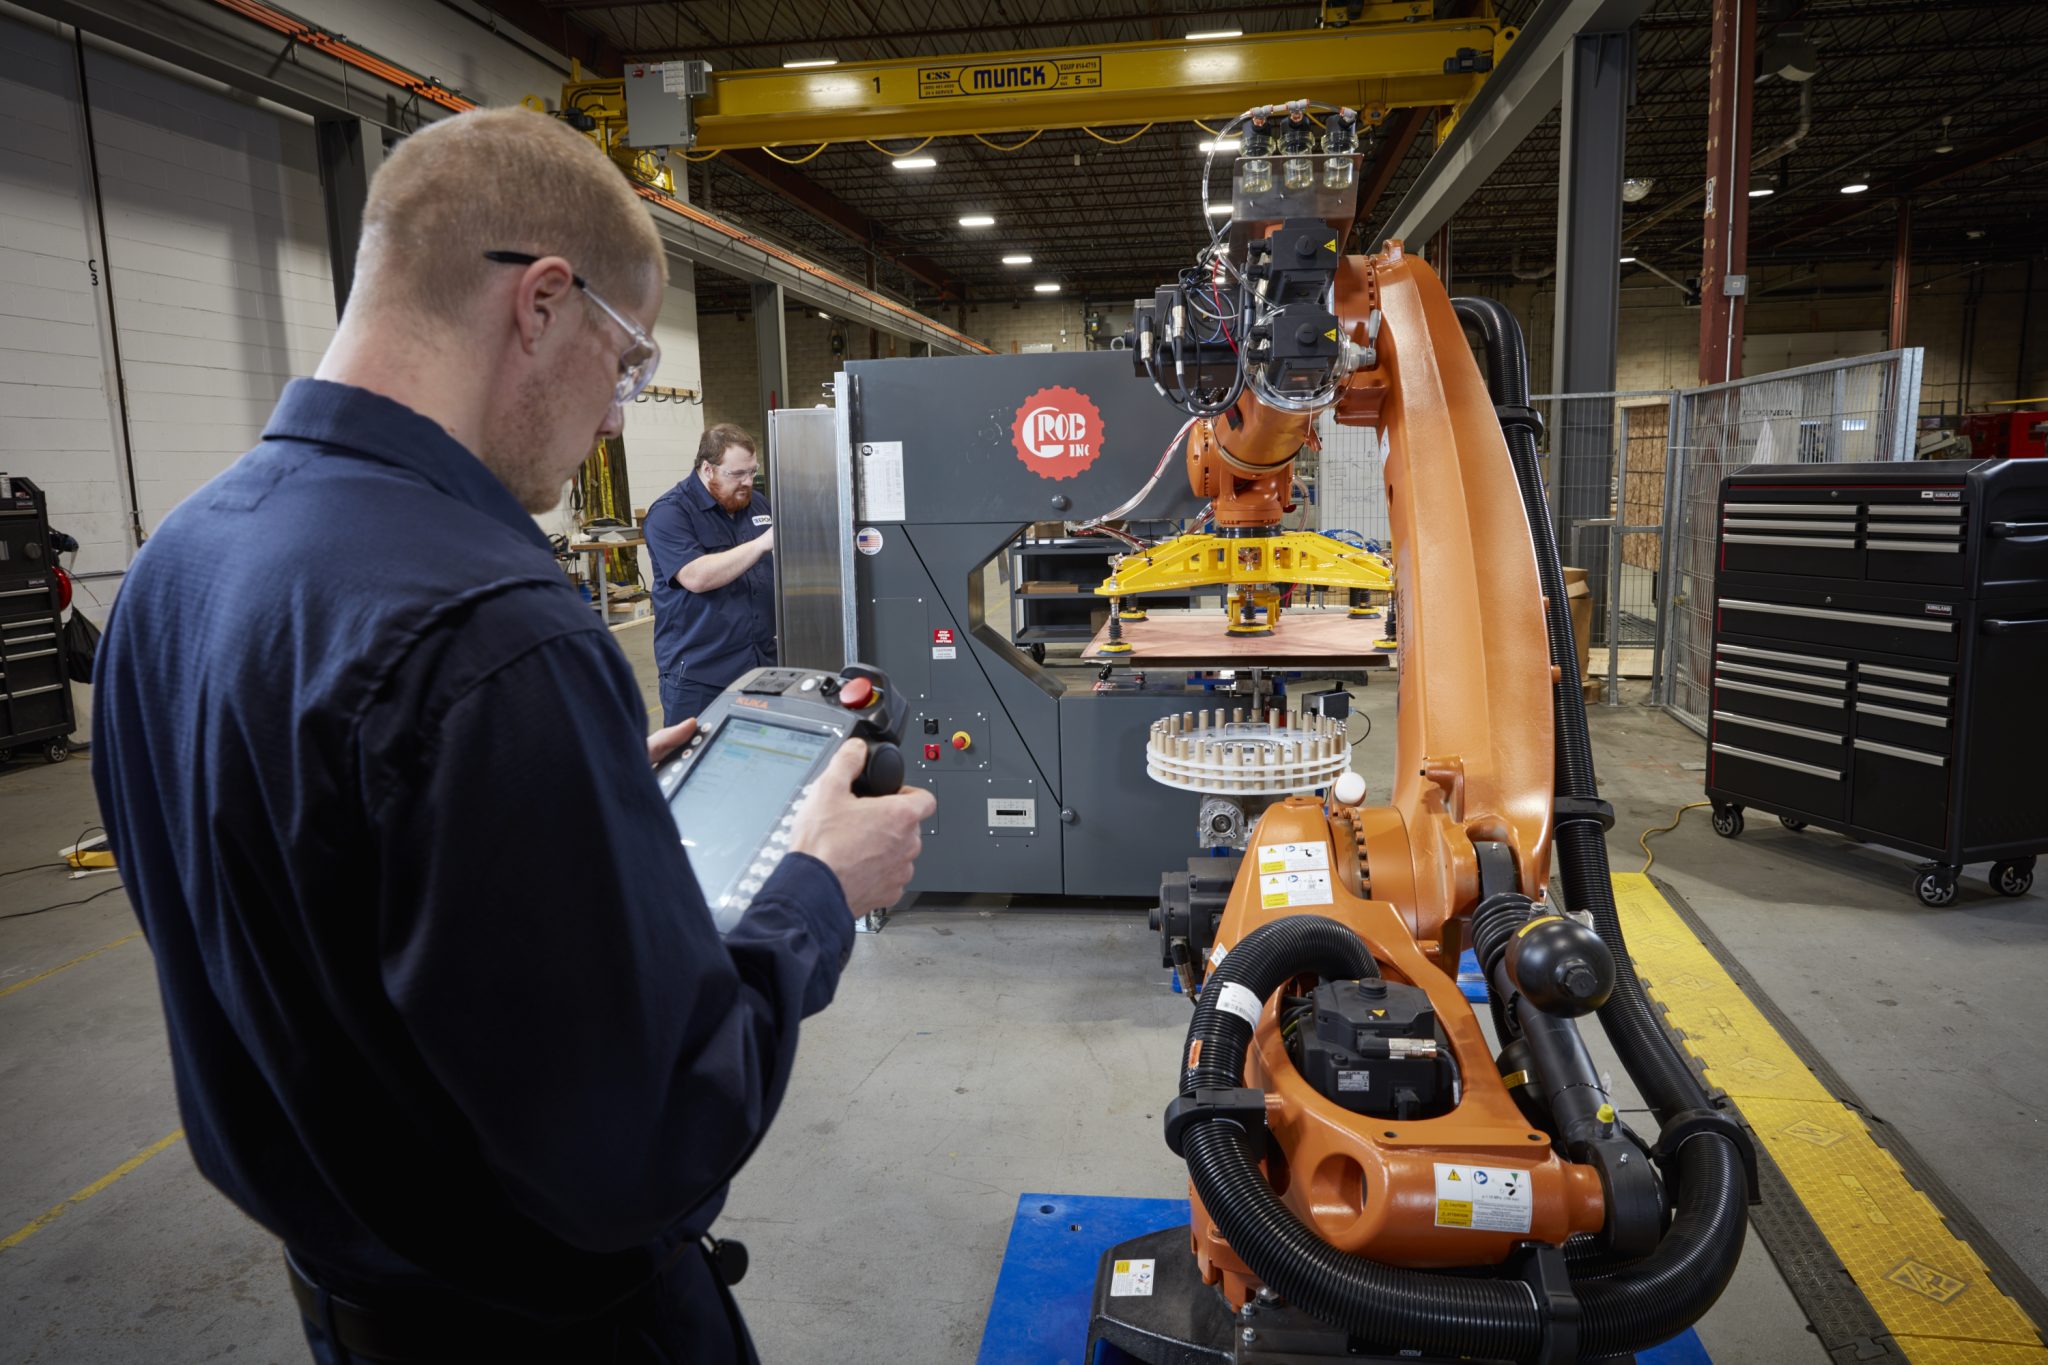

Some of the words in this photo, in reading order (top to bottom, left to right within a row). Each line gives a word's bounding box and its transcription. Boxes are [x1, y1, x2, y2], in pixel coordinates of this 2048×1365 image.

[926, 71, 951, 80] CSS
[973, 65, 1046, 89] MUNCK
[1075, 75, 1081, 85] 5
[872, 76, 881, 94] 1
[1022, 406, 1086, 458] GROB
[1069, 444, 1090, 457] INC
